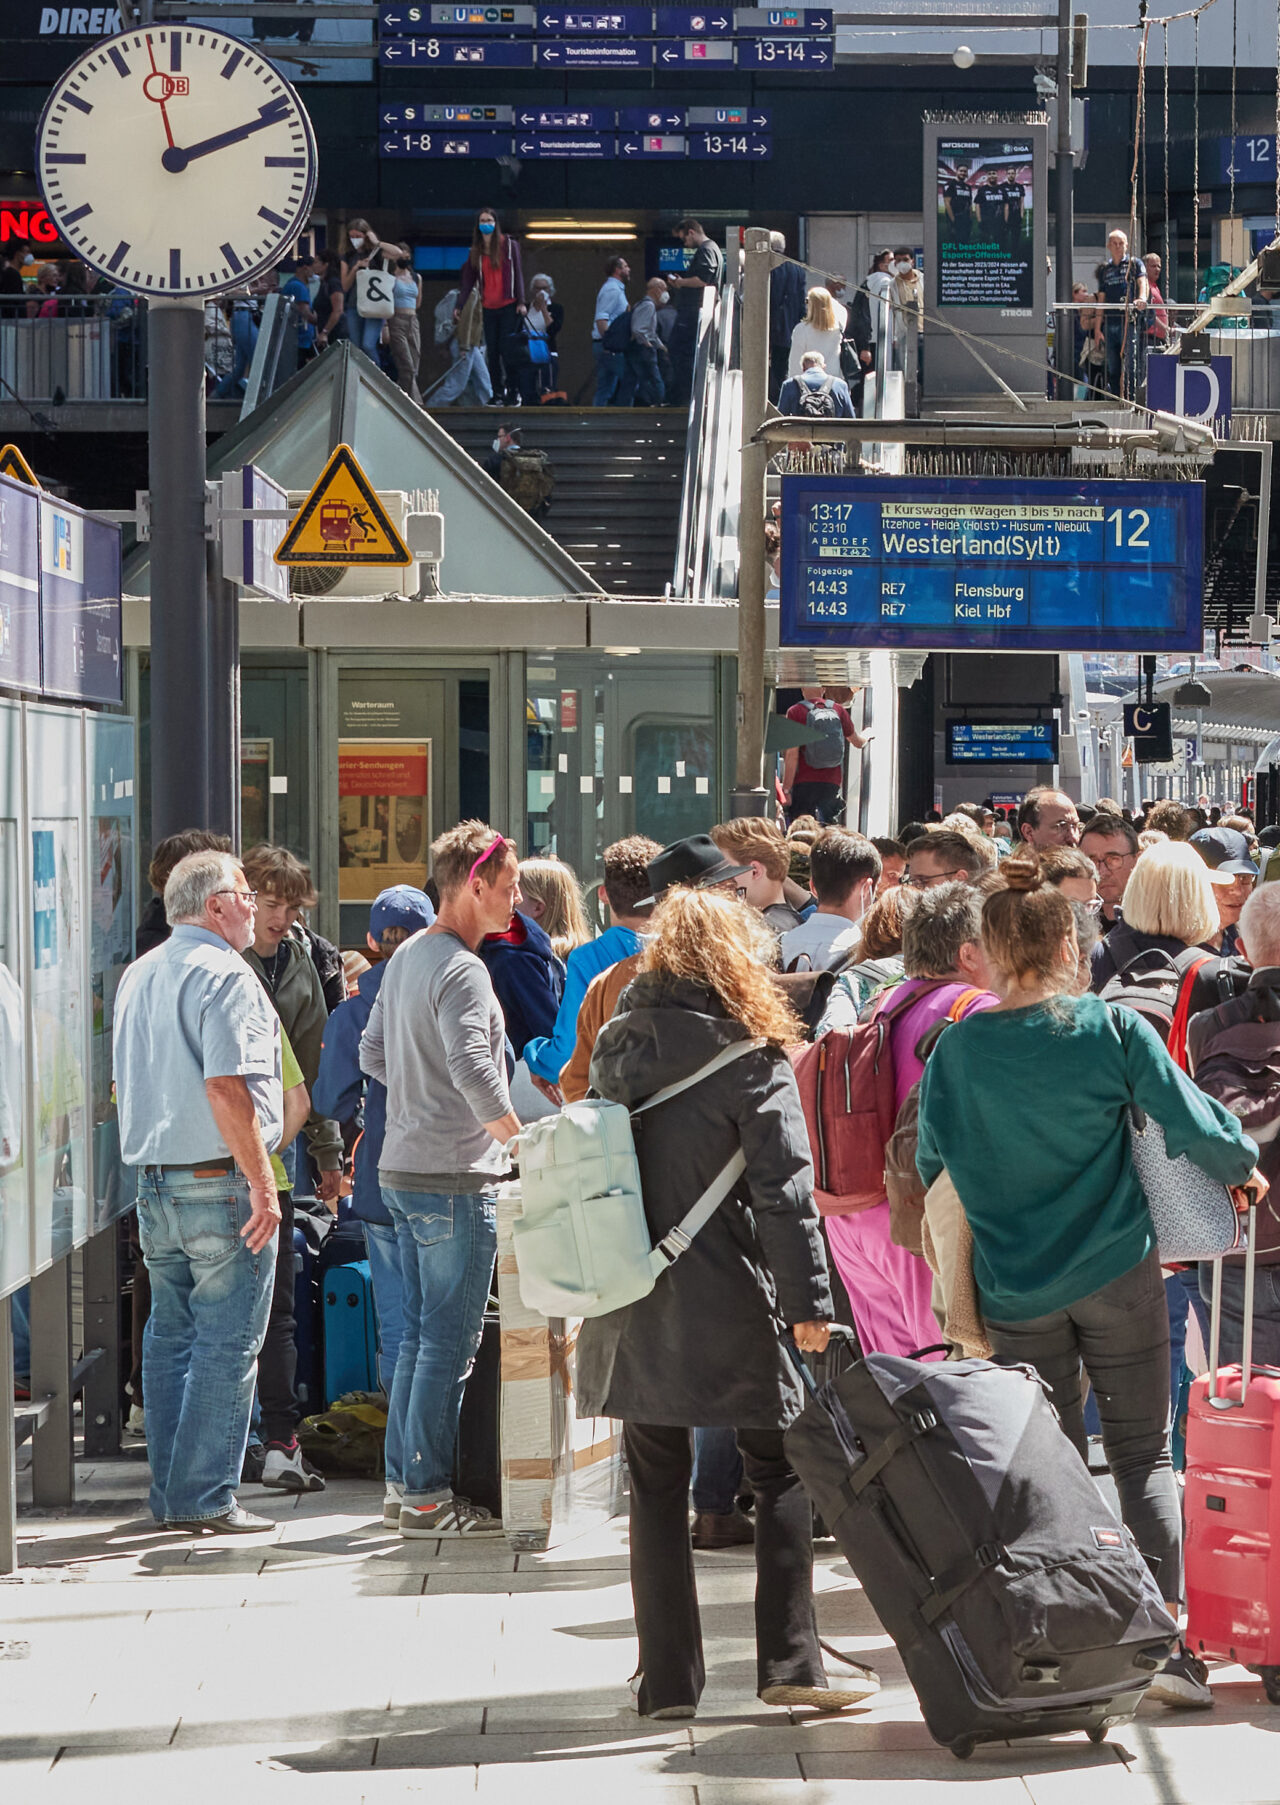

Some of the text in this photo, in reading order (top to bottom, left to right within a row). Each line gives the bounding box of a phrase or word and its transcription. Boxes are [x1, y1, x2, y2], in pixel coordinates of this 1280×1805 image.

[39, 8, 139, 35] DIREK
[408, 8, 422, 21] S
[456, 8, 466, 21] U
[769, 12, 780, 24] U
[409, 39, 440, 58] 1-8
[565, 47, 637, 55] Touristeninformation
[754, 42, 806, 61] 13-14
[164, 78, 187, 94] DB
[404, 108, 416, 120] S
[446, 108, 455, 119] U
[716, 110, 726, 121] U
[403, 135, 432, 151] 1-8
[703, 137, 748, 153] 13-14
[1246, 139, 1270, 162] 12
[0, 210, 59, 242] NG
[942, 252, 1011, 260] Esports-Offensive
[1000, 309, 1033, 317] STRÖER
[1175, 365, 1221, 423] D
[810, 503, 853, 521] 13:17
[894, 505, 966, 517] Kurswagen
[969, 506, 1017, 519] (Wagen
[1020, 507, 1028, 517] 3
[1031, 507, 1050, 517] bis
[1067, 508, 1098, 518] nach
[809, 523, 847, 533] IC 2310
[882, 520, 921, 530] Itzehoe
[931, 521, 960, 531] Heide
[962, 520, 1000, 532] (Holst)
[1009, 521, 1045, 532] Husum
[1054, 521, 1091, 533] Niebüll
[1107, 508, 1150, 547] 12
[882, 533, 1061, 560] Westerland(Sylt)
[807, 566, 853, 577] Folgezüge
[808, 580, 1025, 601] 14:43 RE7 Flensburg
[807, 601, 1012, 618] 14:43 RE7 Kiel Hbf
[351, 701, 395, 709] Warteraum
[1133, 707, 1153, 732] C
[1033, 725, 1045, 737] 12
